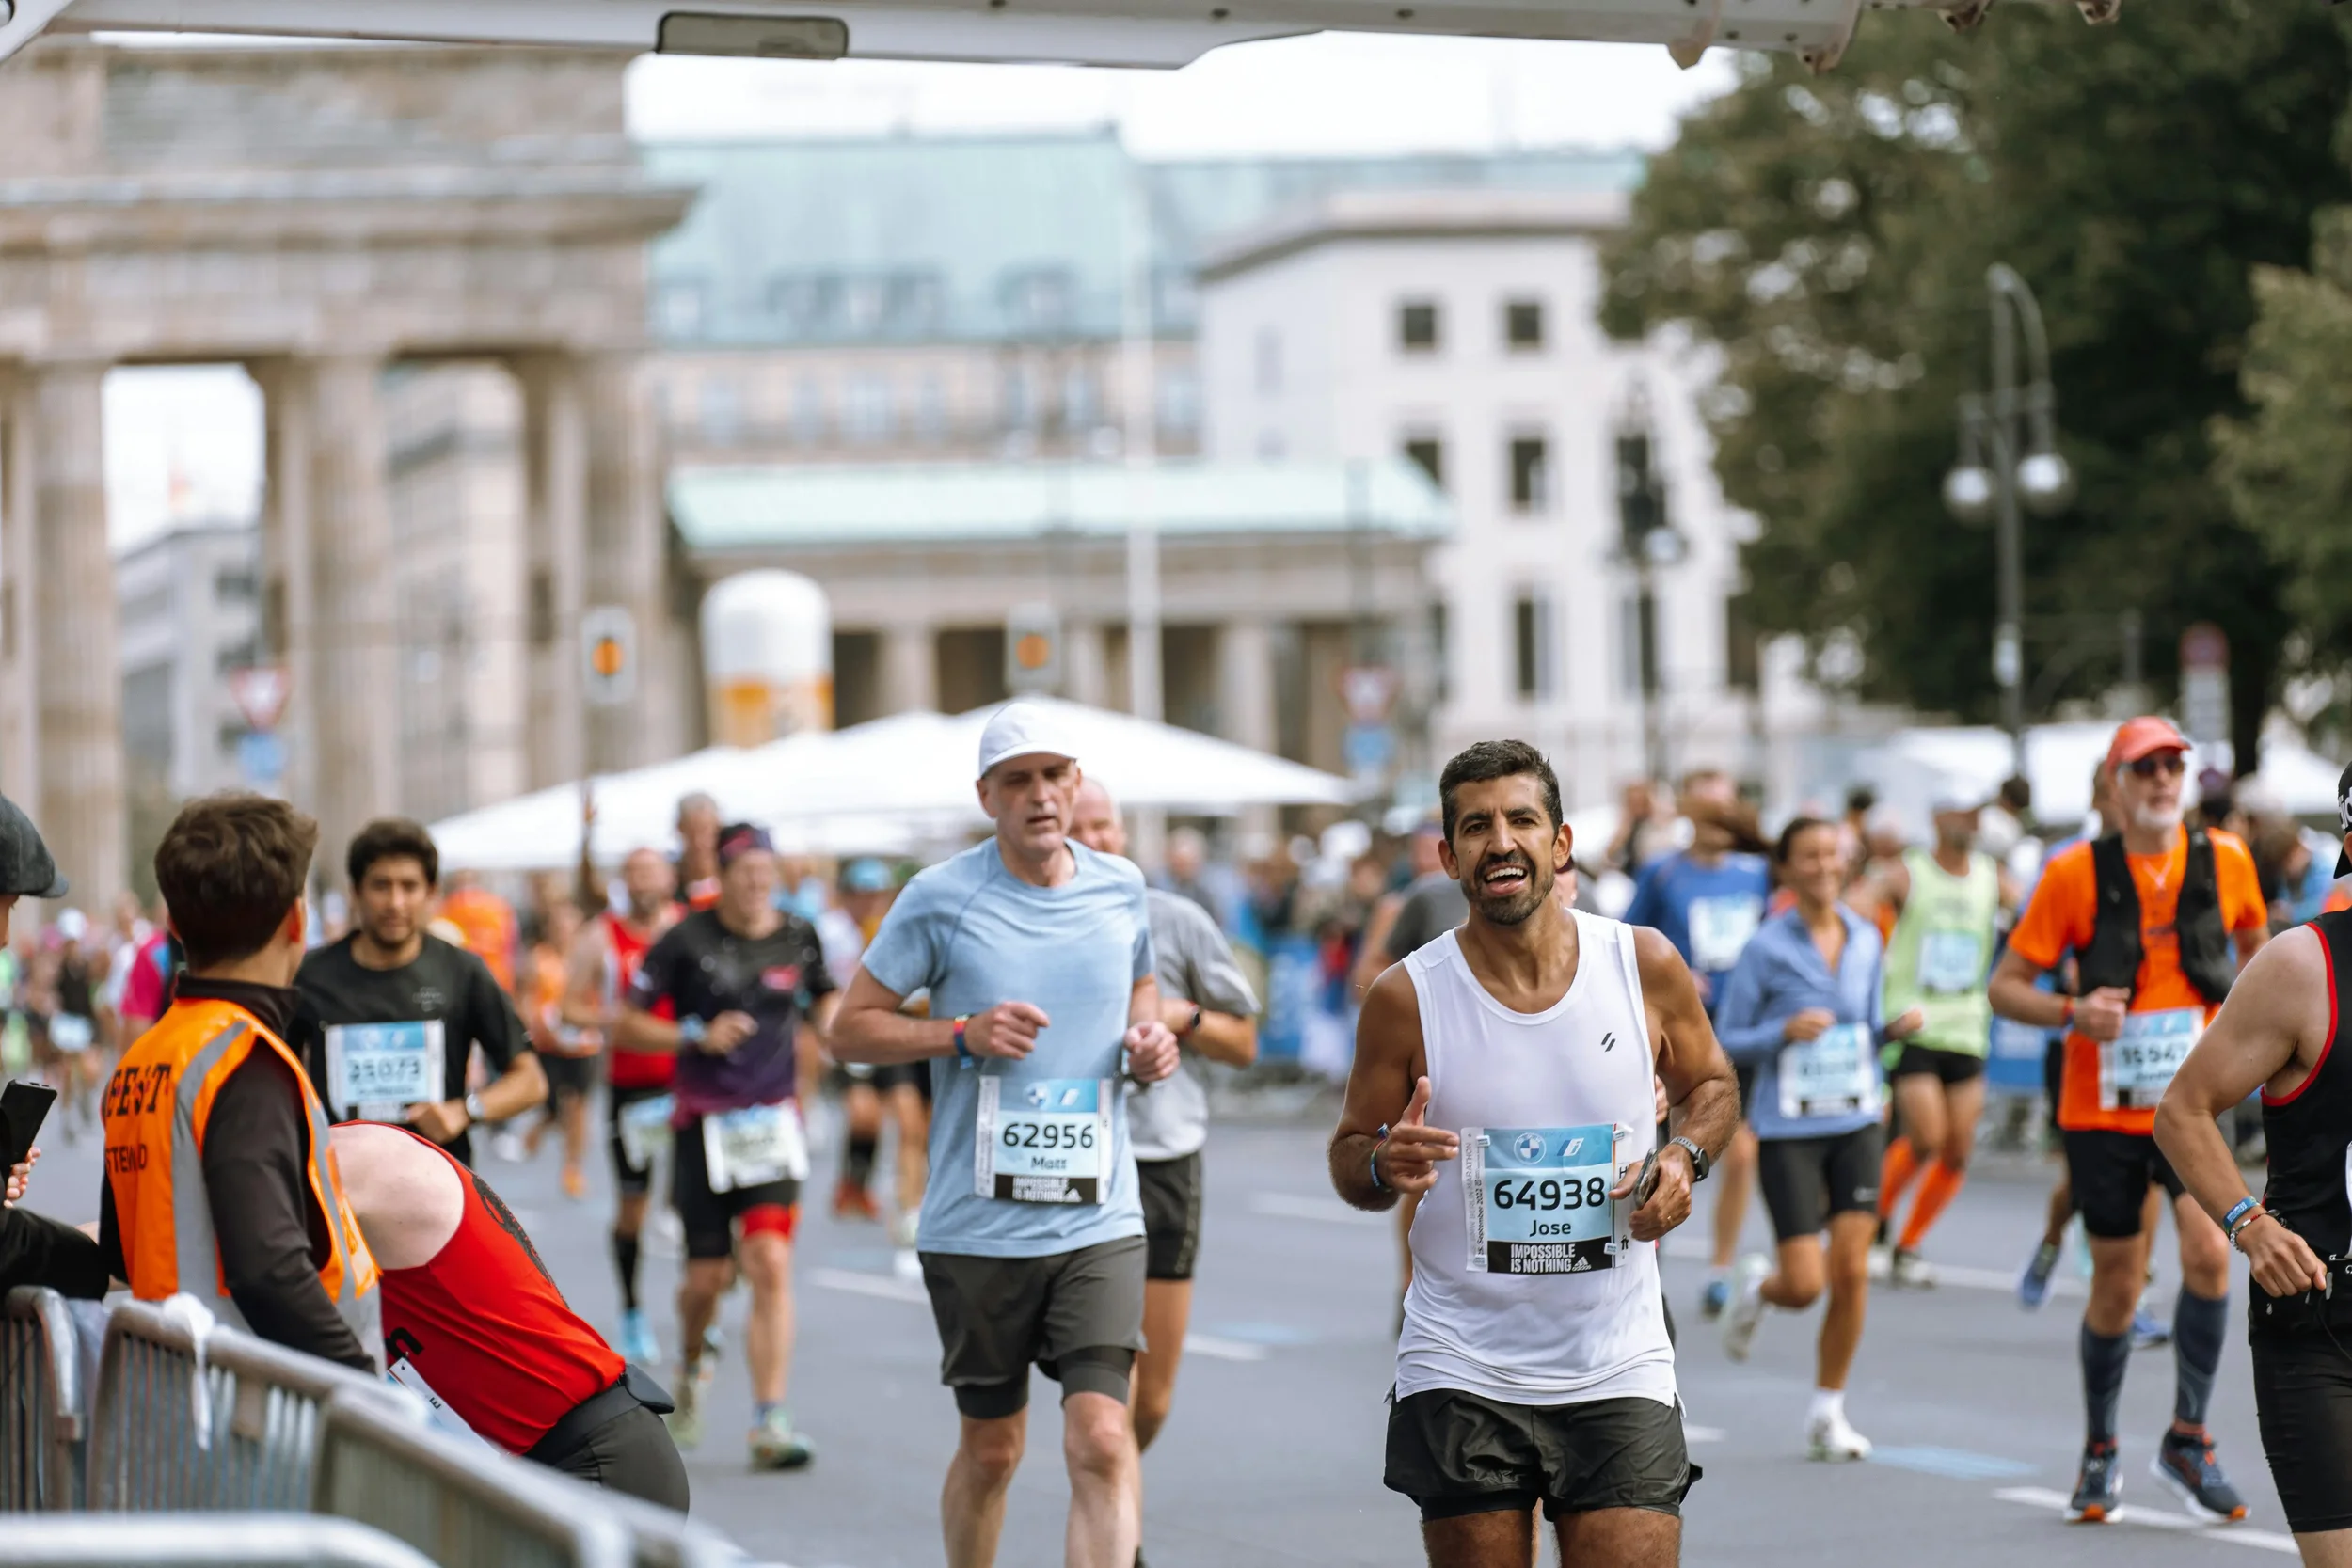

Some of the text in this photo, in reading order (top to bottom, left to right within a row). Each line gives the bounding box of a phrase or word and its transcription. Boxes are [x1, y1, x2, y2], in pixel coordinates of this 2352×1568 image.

[1003, 1122, 1094, 1149] 62956
[1030, 1156, 1067, 1169] Matt
[1465, 1142, 1473, 1189] MARATHON
[1494, 1177, 1605, 1211] 64938
[1529, 1219, 1572, 1237] Jose
[1510, 1243, 1576, 1259] IMPOSSIBLE
[1510, 1259, 1522, 1273] IS
[1522, 1258, 1572, 1273] NOTHING
